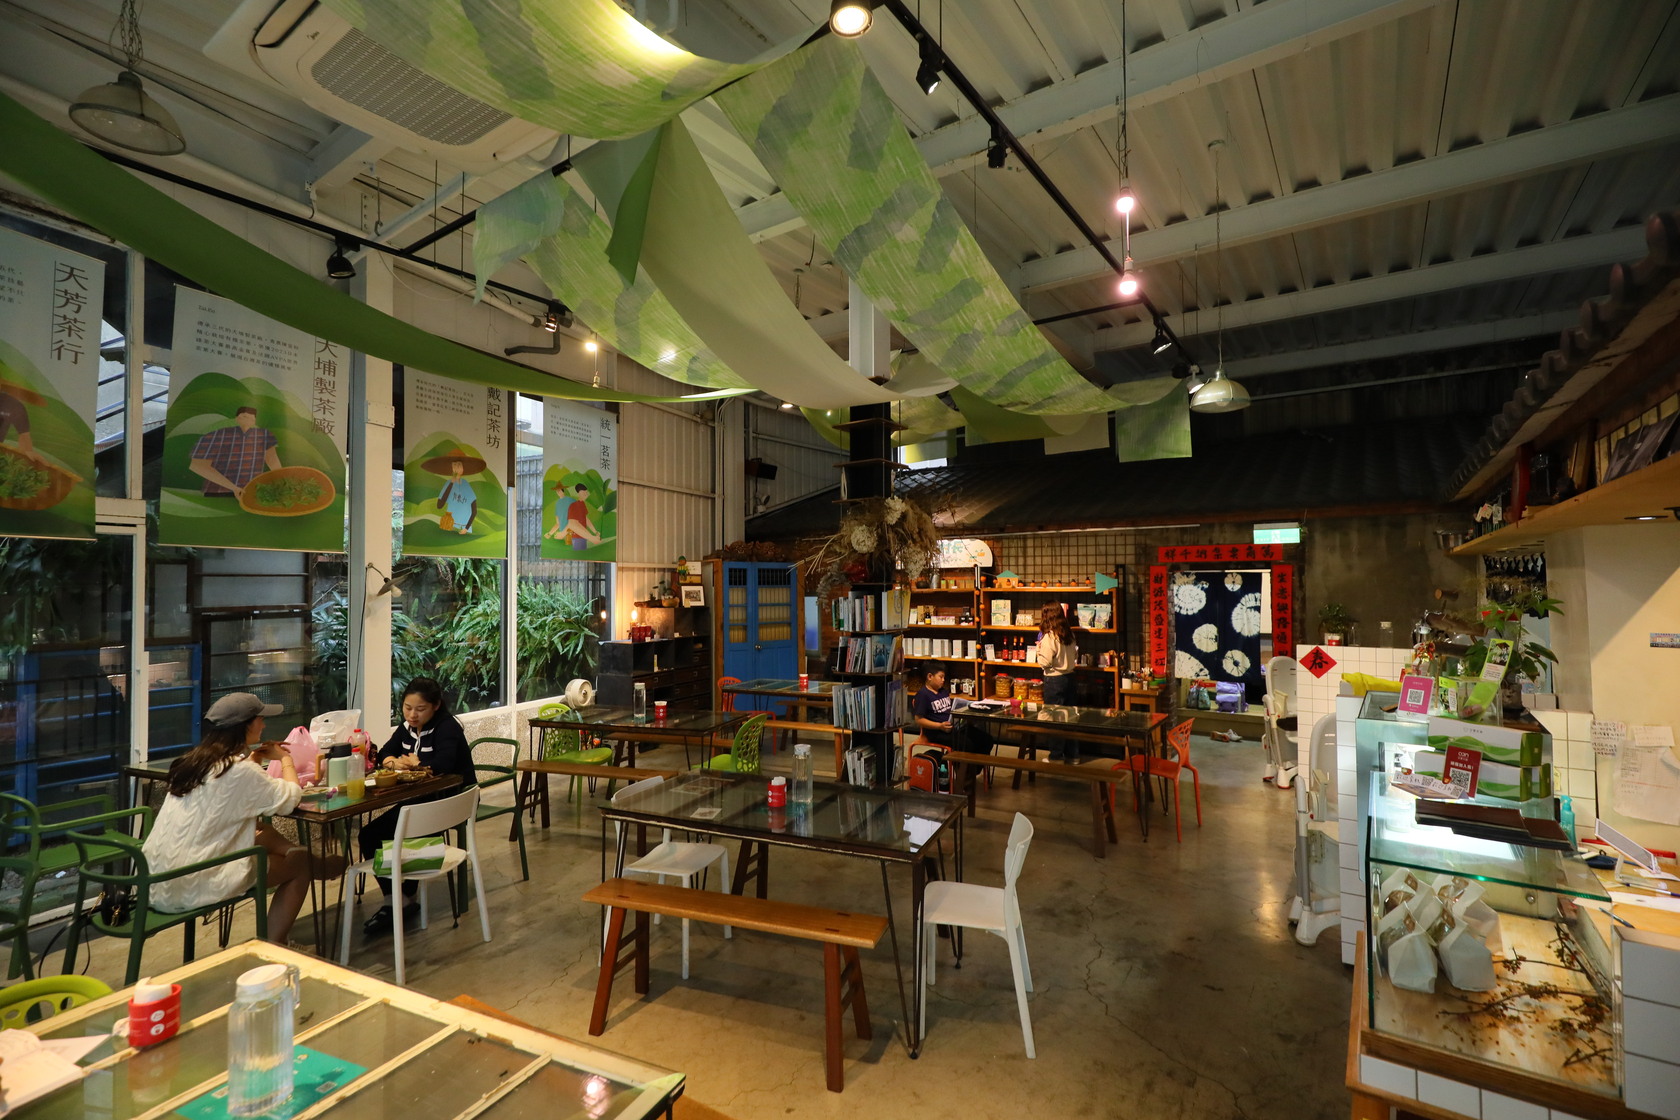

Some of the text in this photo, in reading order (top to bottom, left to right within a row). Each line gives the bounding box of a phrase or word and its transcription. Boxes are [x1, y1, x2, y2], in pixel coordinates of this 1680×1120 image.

[53, 263, 88, 365] 天芳茶行
[312, 340, 338, 436] 大埔製茶廠
[487, 387, 502, 449] 戴記茶坊
[600, 417, 611, 471] 統一茗茶
[1309, 649, 1329, 671] 春
